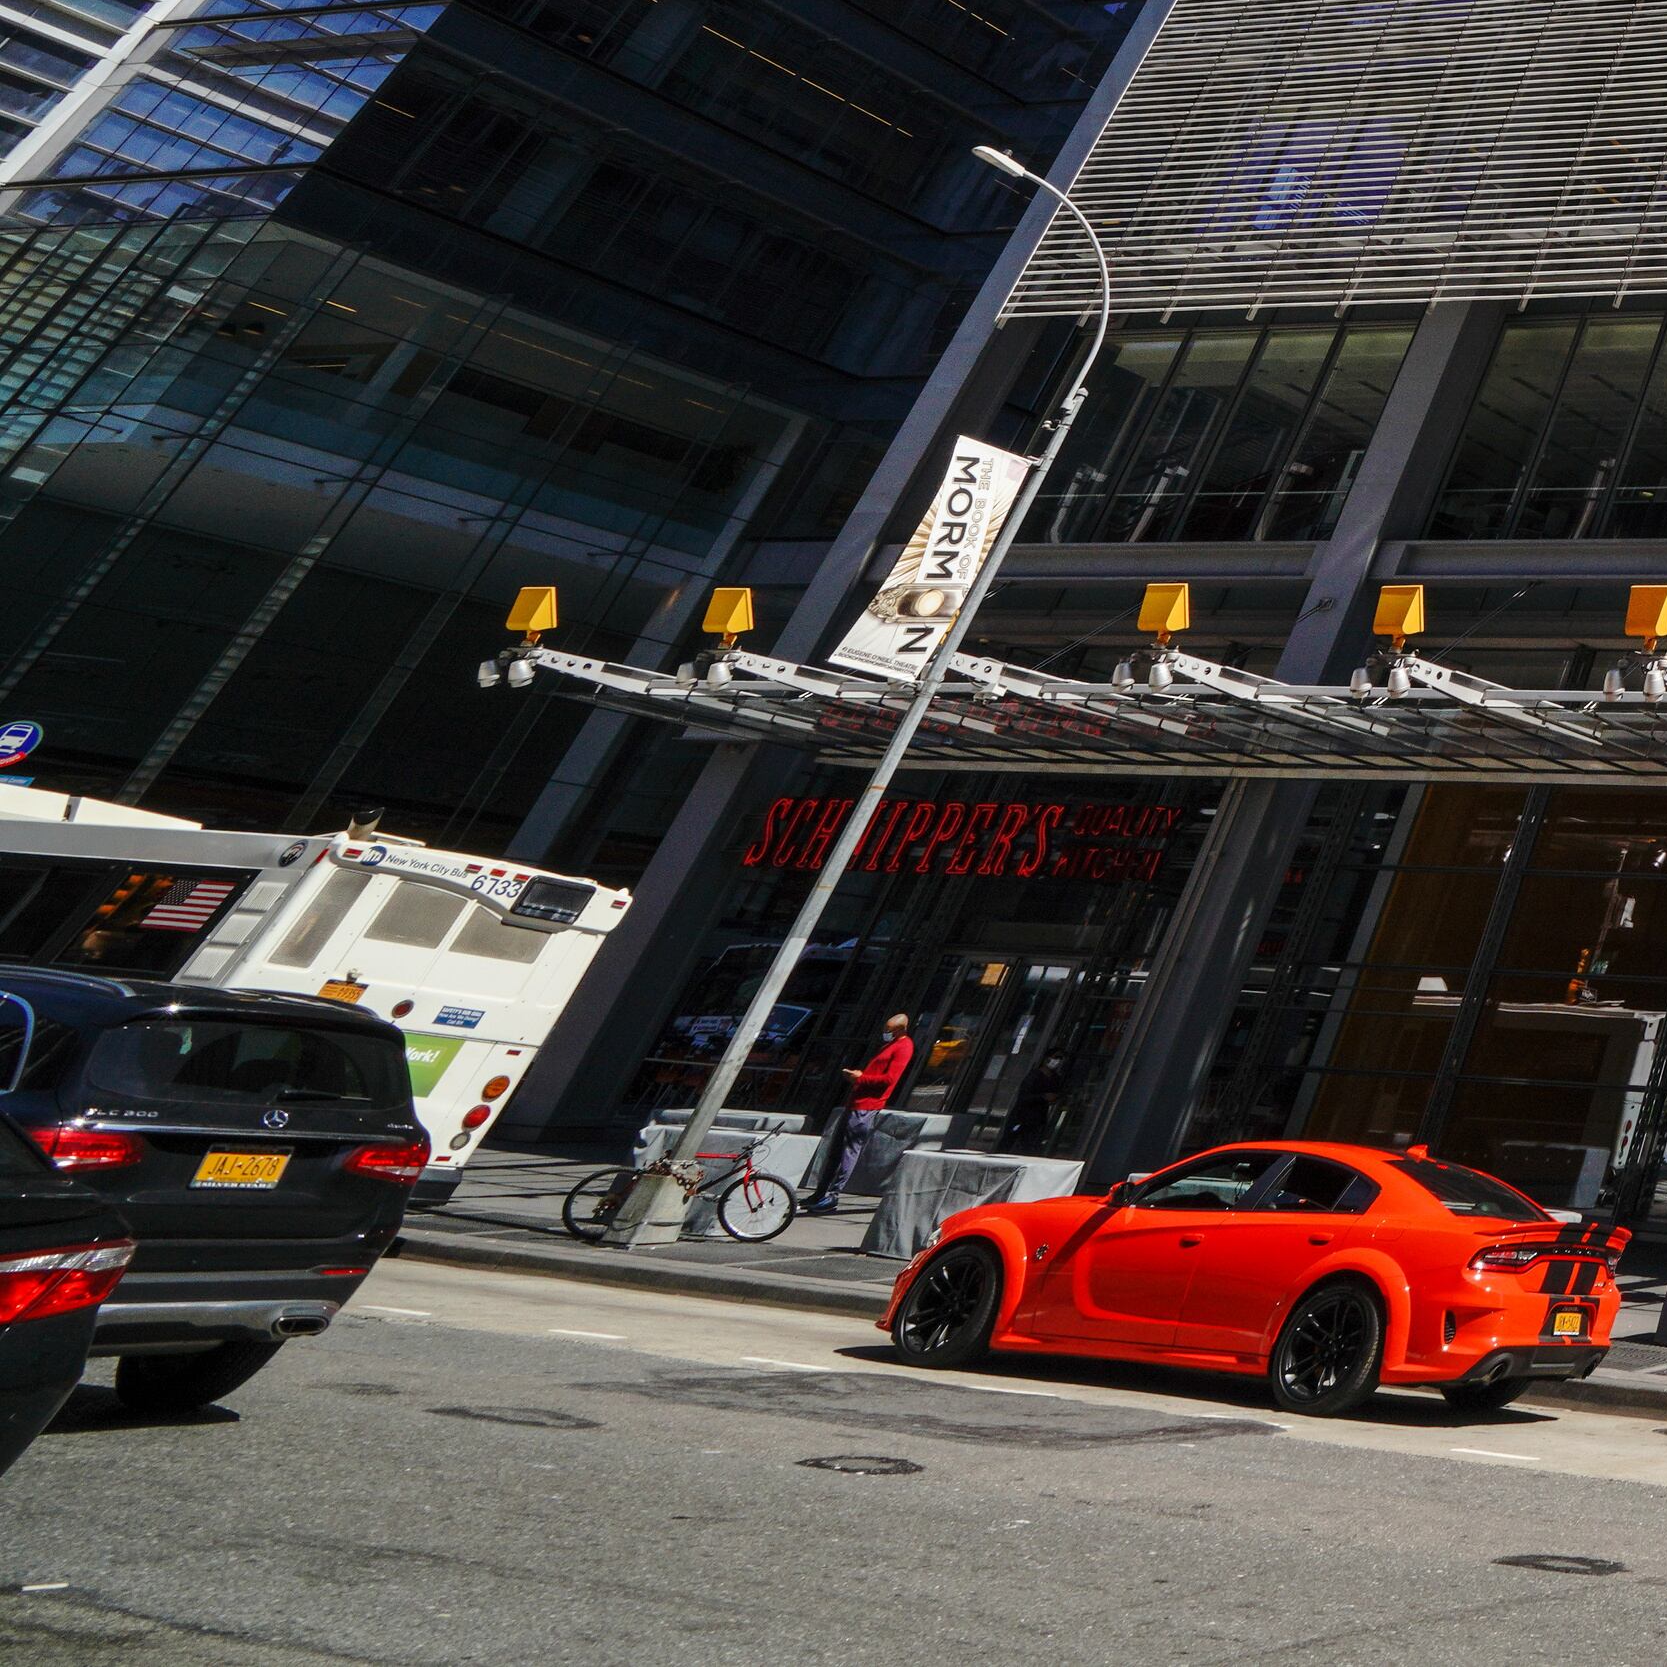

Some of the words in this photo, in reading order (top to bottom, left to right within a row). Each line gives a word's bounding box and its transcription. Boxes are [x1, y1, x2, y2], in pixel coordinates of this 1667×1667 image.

[977, 458, 995, 491] THE
[964, 499, 989, 549] BOOK
[958, 555, 972, 580] OF
[744, 798, 1067, 878] SCHIPPER'S
[385, 854, 409, 865] New
[409, 859, 430, 871] York
[430, 864, 450, 875] City
[449, 868, 469, 879] Bus
[471, 874, 522, 898] 6733
